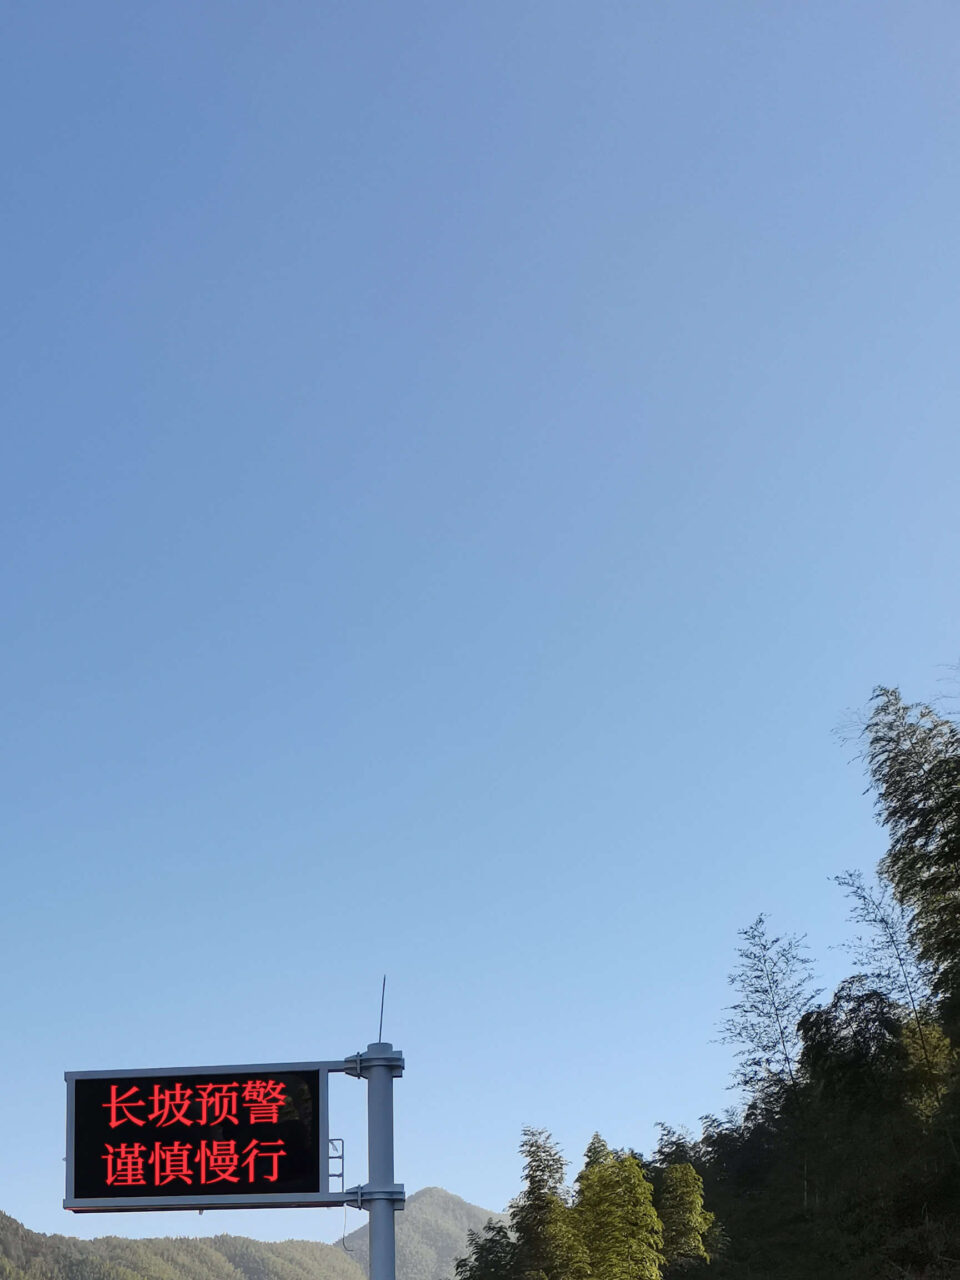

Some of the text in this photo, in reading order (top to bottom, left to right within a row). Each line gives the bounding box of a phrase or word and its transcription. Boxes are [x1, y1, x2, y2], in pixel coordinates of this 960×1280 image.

[102, 1079, 286, 1128] 长坡预警
[101, 1138, 286, 1185] 谨慎慢行
